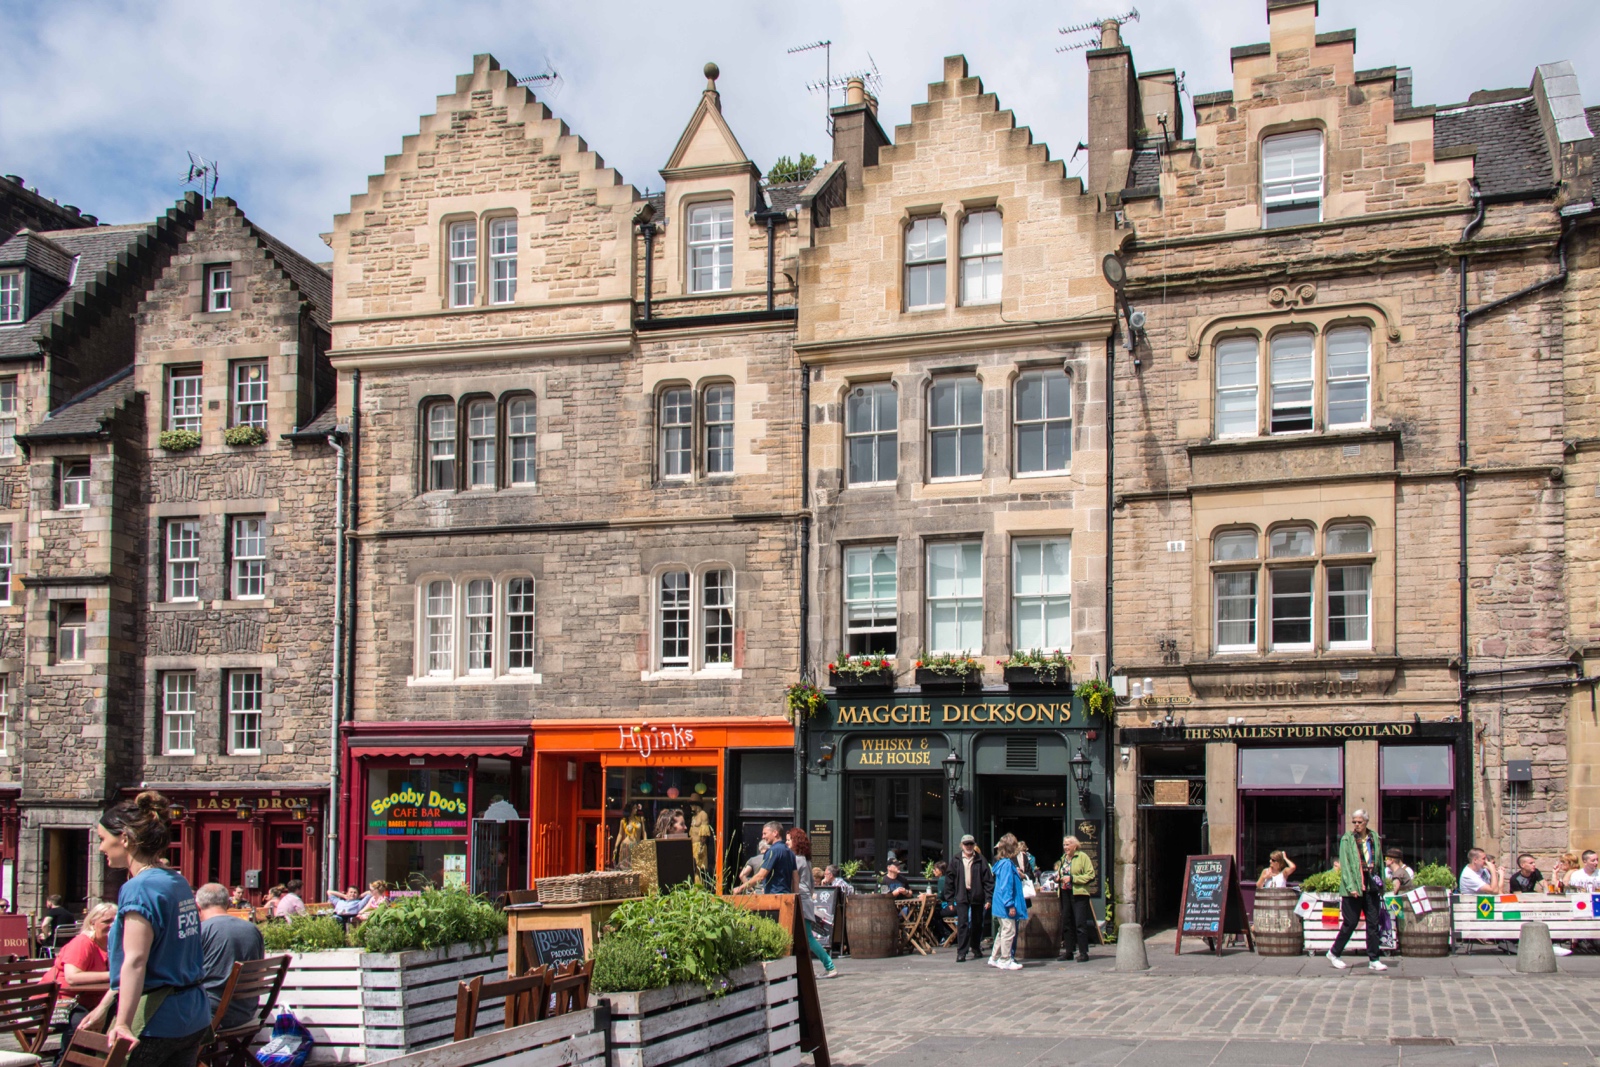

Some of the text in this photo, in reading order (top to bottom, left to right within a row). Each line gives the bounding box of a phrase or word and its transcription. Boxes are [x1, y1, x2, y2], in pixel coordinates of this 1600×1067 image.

[1222, 682, 1298, 697] MISSION
[837, 702, 1071, 724] MAGGIE DICKSON'S
[1183, 724, 1413, 740] THE SMALLEST PUB IN SCOTLAND
[619, 721, 694, 758] Hijinks
[861, 738, 928, 750] WHISKY &
[859, 751, 931, 765] ALE HOUSE
[196, 798, 309, 809] LAST DROP
[370, 787, 467, 816] Scooby Doo's
[393, 808, 441, 818] CAFE BAR
[4, 938, 28, 947] DROP
